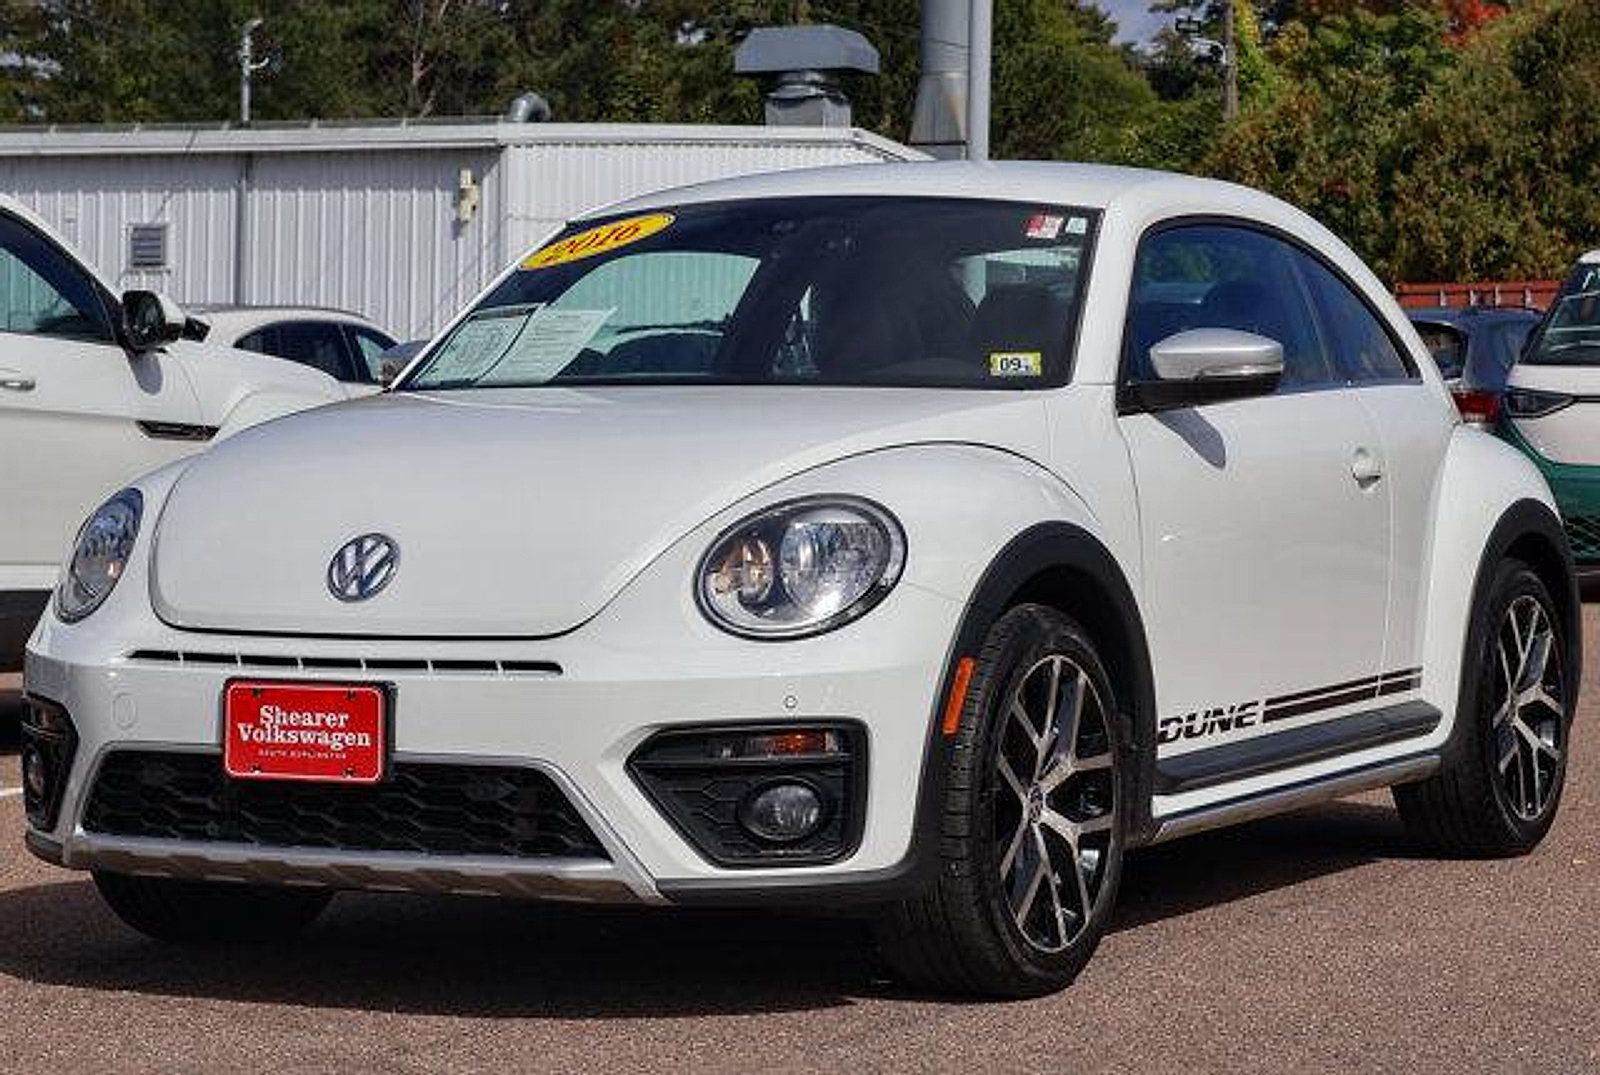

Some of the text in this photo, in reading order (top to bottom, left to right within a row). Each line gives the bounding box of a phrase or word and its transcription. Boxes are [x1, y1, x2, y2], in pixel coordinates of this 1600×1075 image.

[540, 222, 640, 263] 2016
[259, 704, 349, 728] Shearer
[1157, 700, 1260, 744] DUNE
[237, 723, 371, 751] Volkswagen
